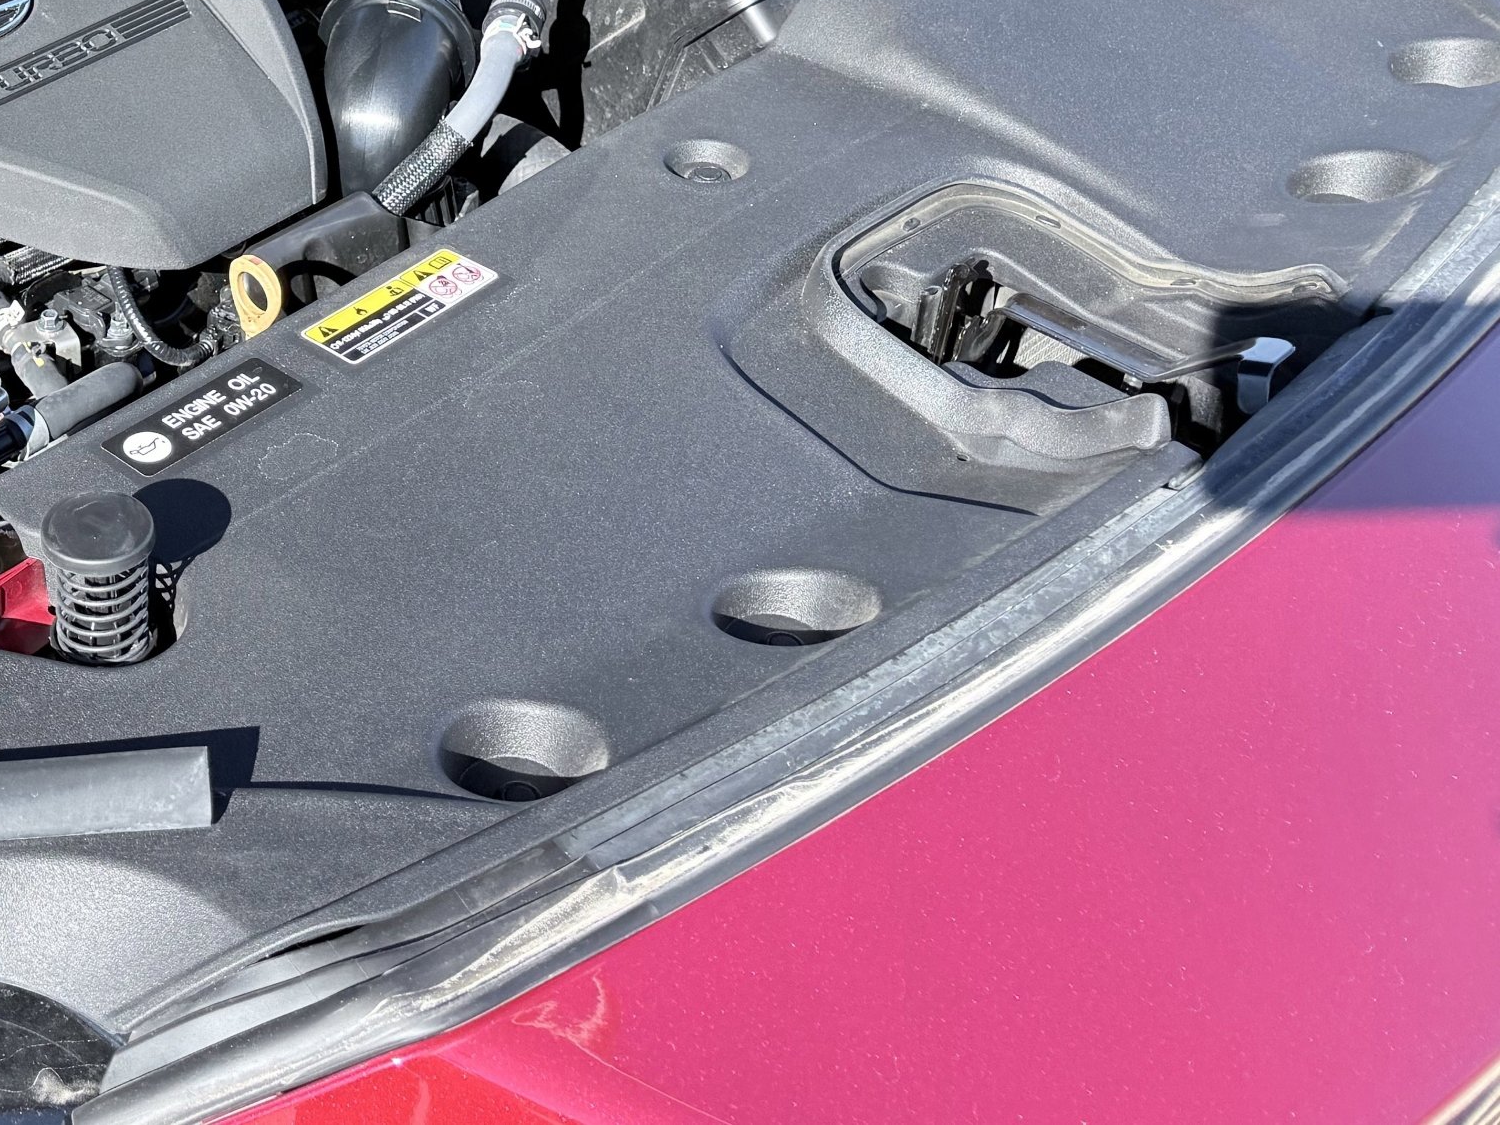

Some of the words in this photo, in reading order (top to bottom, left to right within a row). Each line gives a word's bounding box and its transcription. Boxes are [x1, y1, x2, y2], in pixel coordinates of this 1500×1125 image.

[161, 389, 227, 429] ENGINE
[227, 373, 260, 391] OIL
[181, 414, 222, 440] SAE
[223, 382, 277, 416] 0W-20
